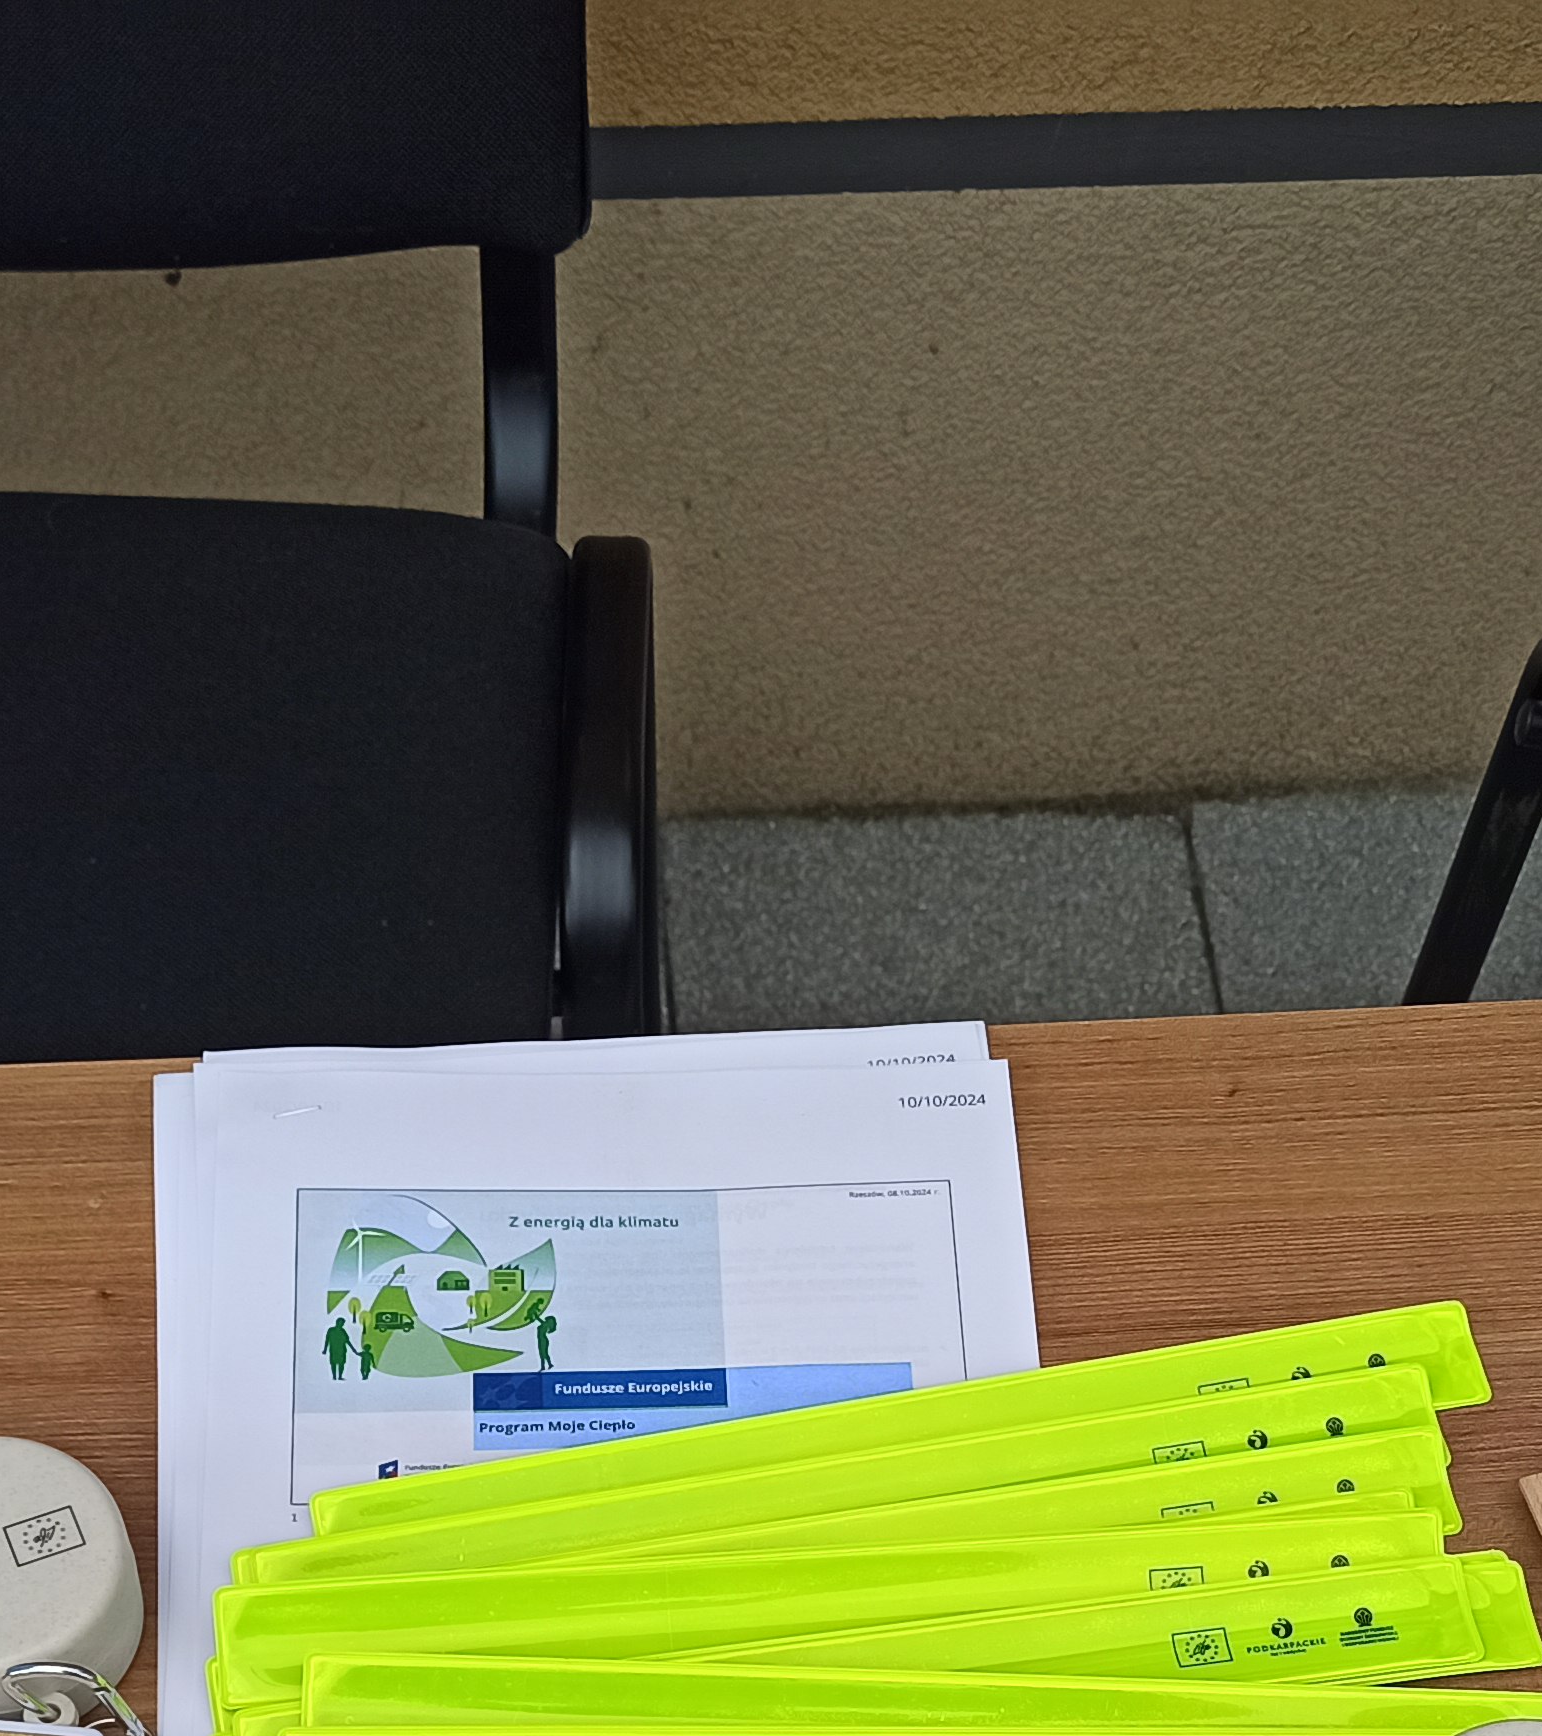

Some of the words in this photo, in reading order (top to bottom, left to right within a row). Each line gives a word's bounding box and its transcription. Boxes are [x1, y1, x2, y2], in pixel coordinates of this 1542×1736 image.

[898, 1093, 985, 1108] 10/10/2024
[508, 1216, 518, 1227] Z
[523, 1215, 584, 1230] energią
[589, 1215, 613, 1227] dla
[618, 1215, 678, 1227] klimatu
[554, 1382, 624, 1394] Fundusze
[627, 1380, 712, 1395] Europejskie
[479, 1422, 543, 1435] Program
[548, 1420, 585, 1433] Moje
[588, 1419, 635, 1432] Ciepło
[1246, 1637, 1327, 1654] PODKARPACKIE
